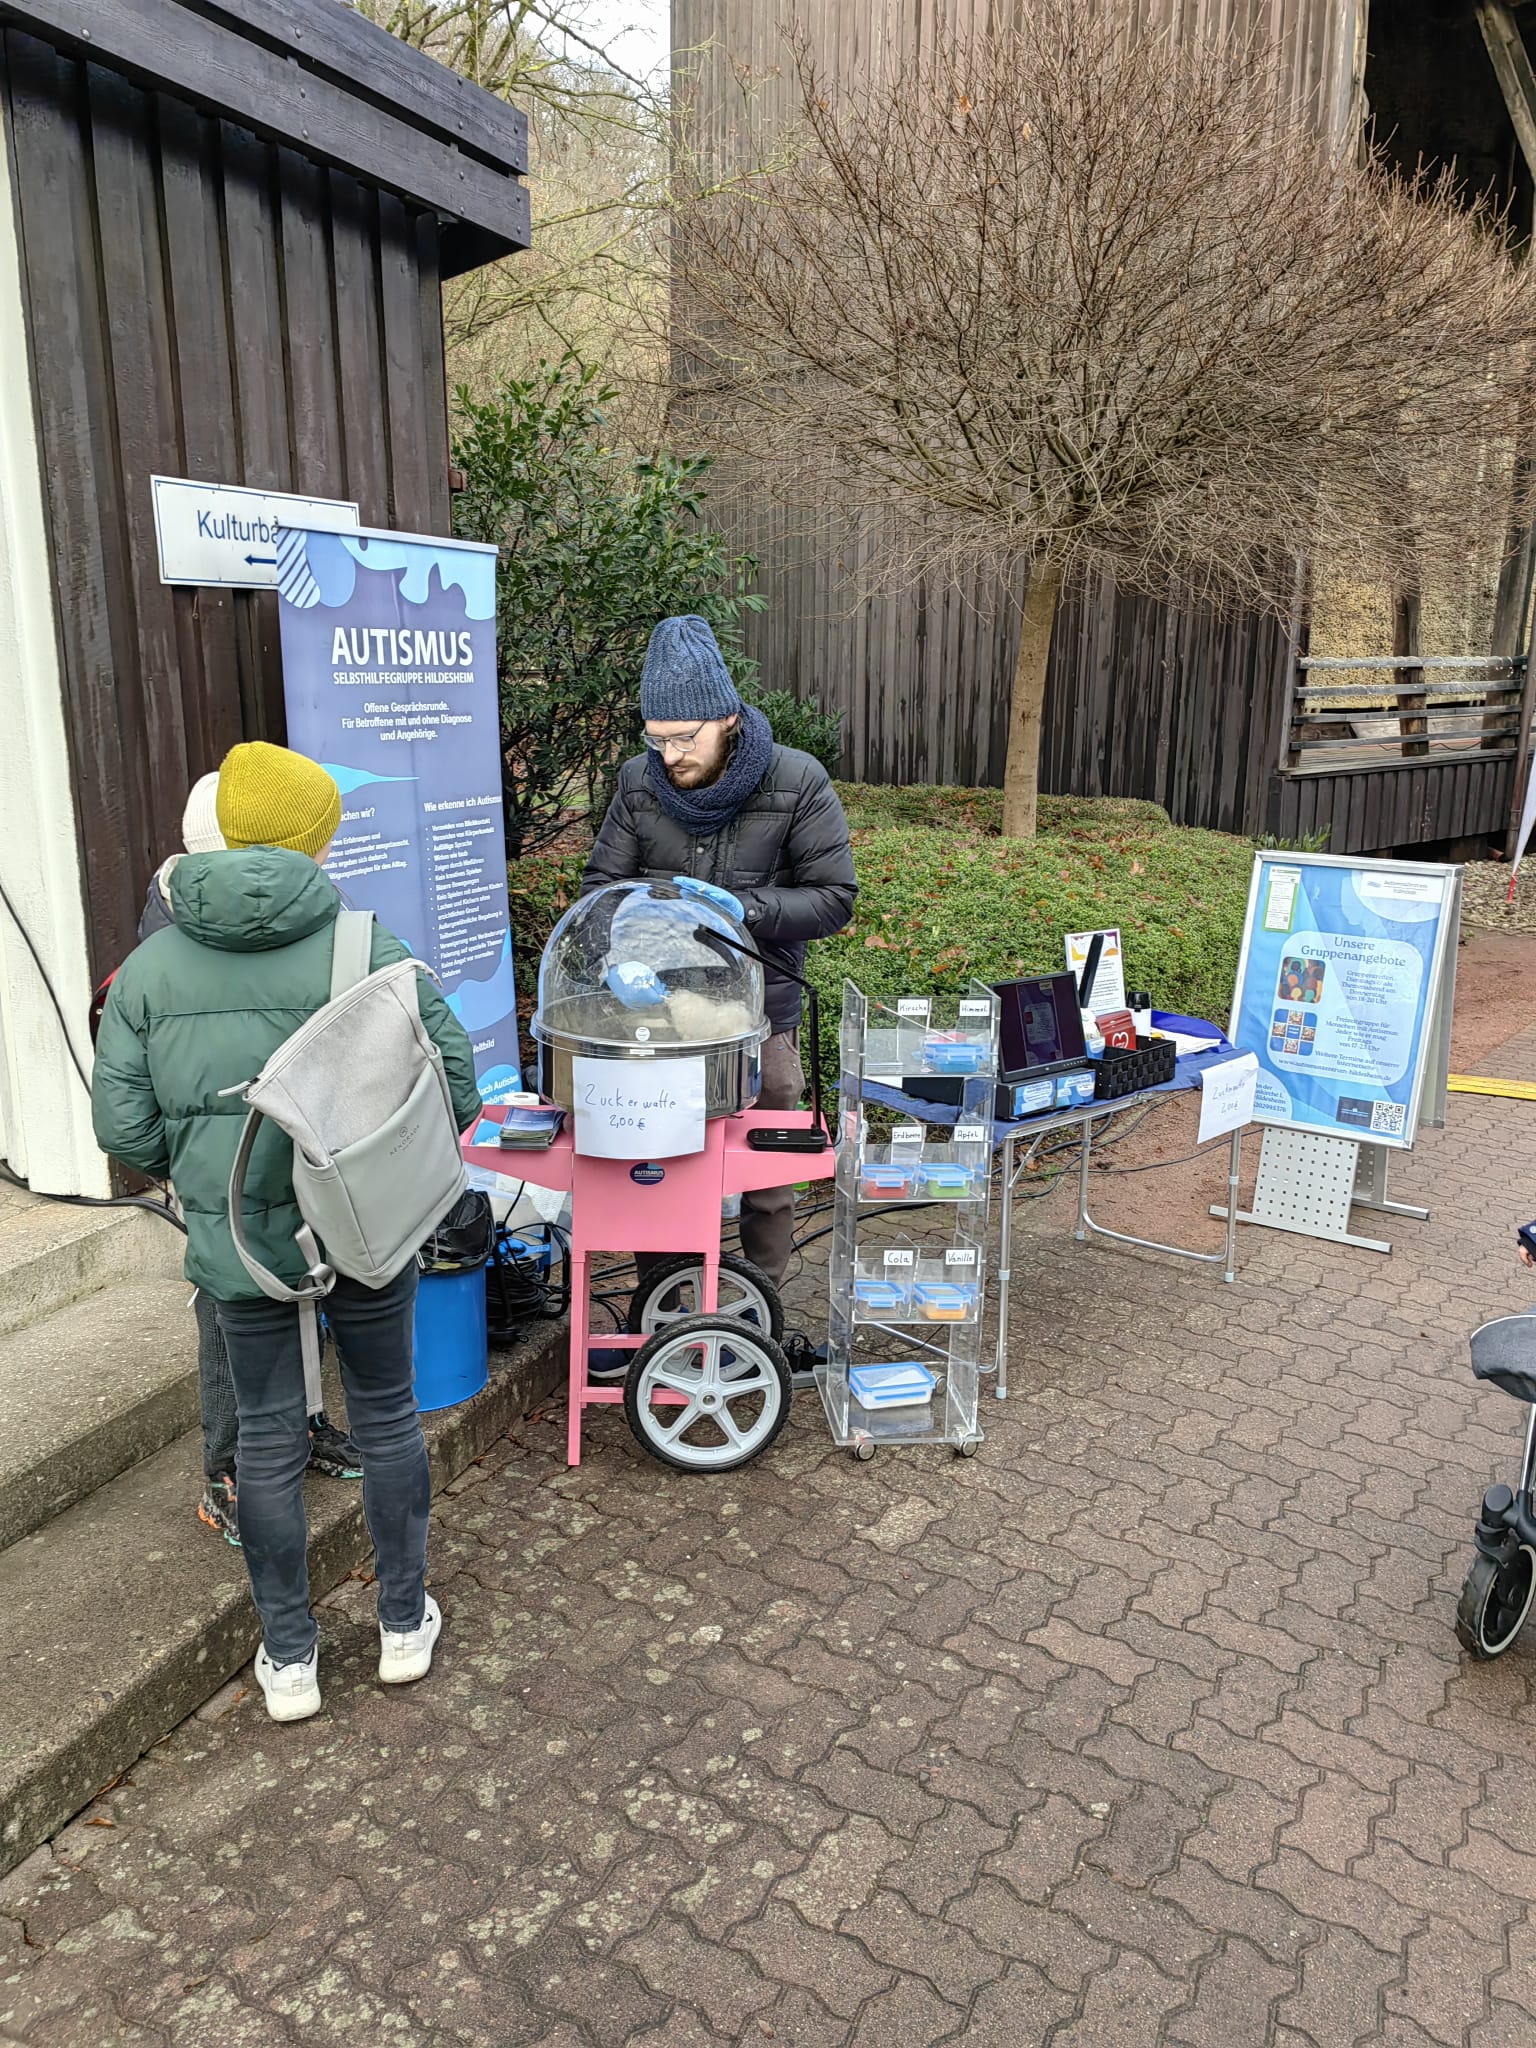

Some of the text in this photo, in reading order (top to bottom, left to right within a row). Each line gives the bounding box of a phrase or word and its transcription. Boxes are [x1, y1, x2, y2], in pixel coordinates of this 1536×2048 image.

[331, 626, 474, 667] AUTISMUS
[333, 671, 475, 685] SELBSTHILFEGRUPPE HILDESHEIM
[363, 702, 390, 713] Offene
[342, 712, 473, 729] Für Betroffene mit und ohne Diagnose
[380, 730, 396, 741] und
[424, 801, 437, 813] Wie
[438, 799, 465, 811] erkenne
[465, 797, 477, 808] ich
[1334, 936, 1376, 953] Unsere
[1301, 945, 1406, 968] Gruppenangebote
[887, 1252, 911, 1264] Cola
[948, 1251, 974, 1263] Vanille
